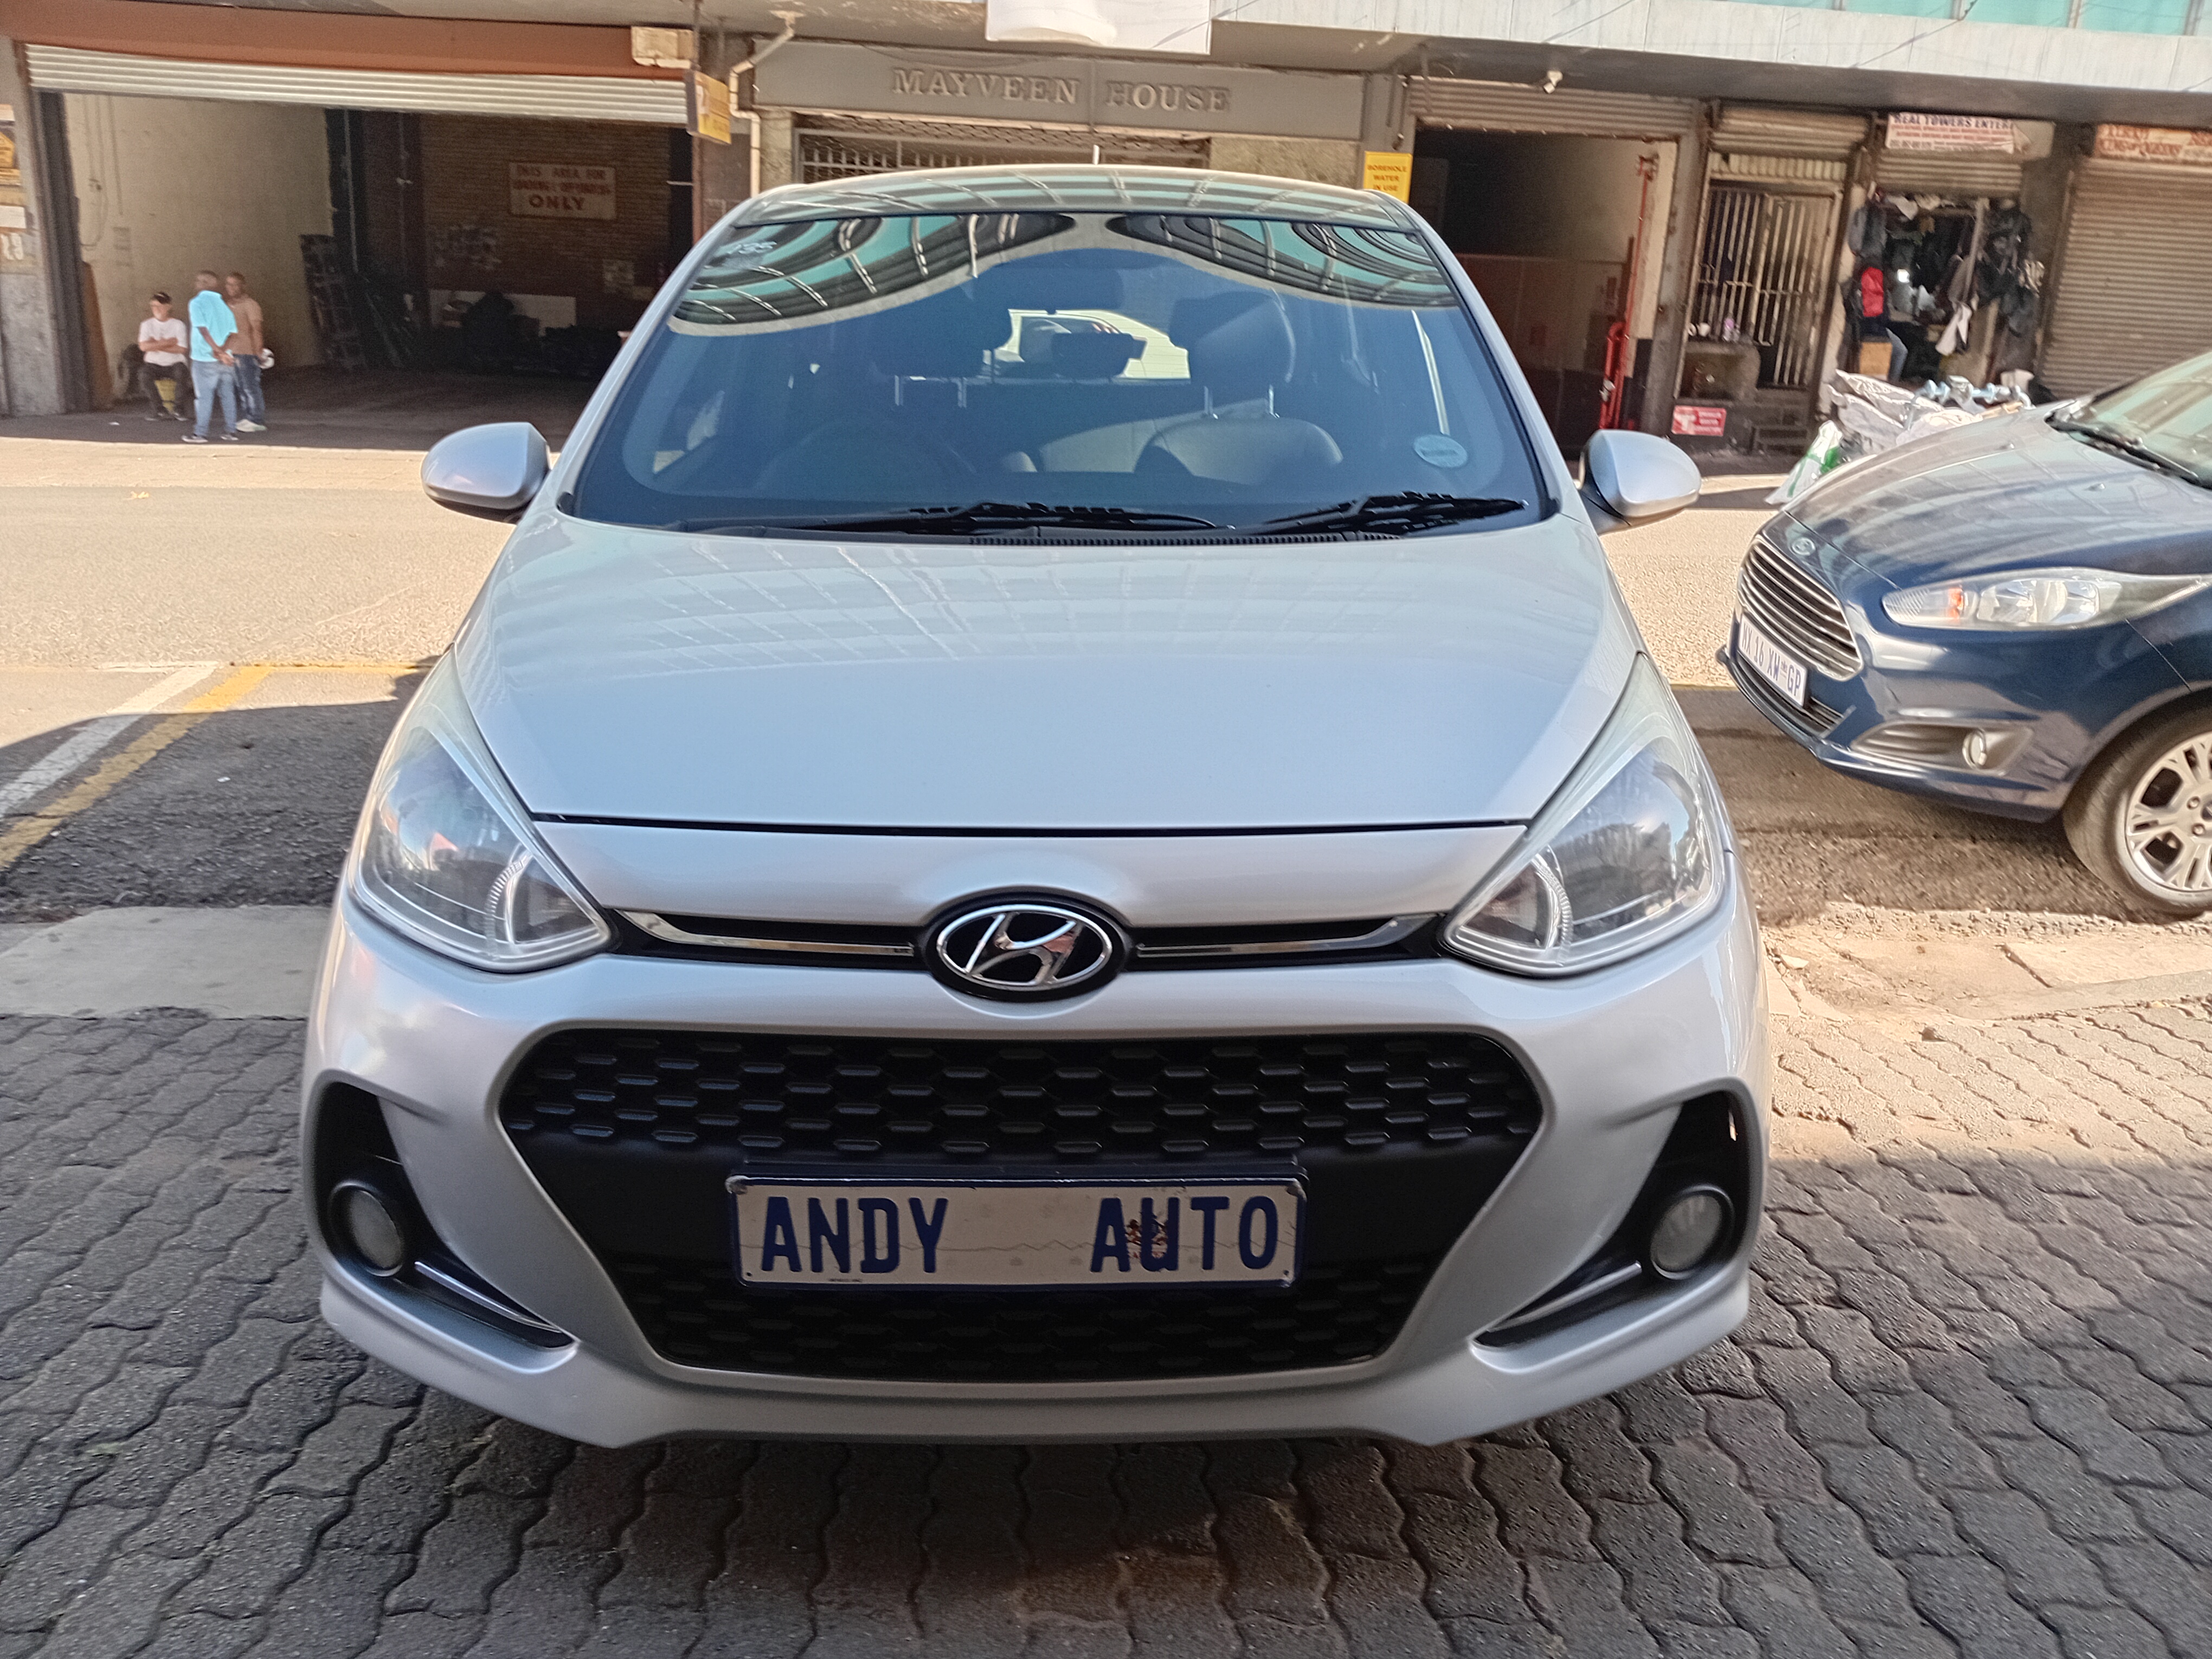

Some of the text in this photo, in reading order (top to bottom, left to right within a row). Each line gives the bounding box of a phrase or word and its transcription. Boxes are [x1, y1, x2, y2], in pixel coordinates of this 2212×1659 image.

[892, 67, 1230, 112] MAYVEEN HOUSE
[1894, 112, 1921, 125] REAL
[1925, 114, 1972, 128] TOWERS
[1367, 164, 1407, 172] BOREHOLE
[528, 194, 586, 211] ONLY
[1753, 635, 1765, 667] 16
[1787, 664, 1802, 696] GP
[761, 1195, 1278, 1274] ANDY AUTO
